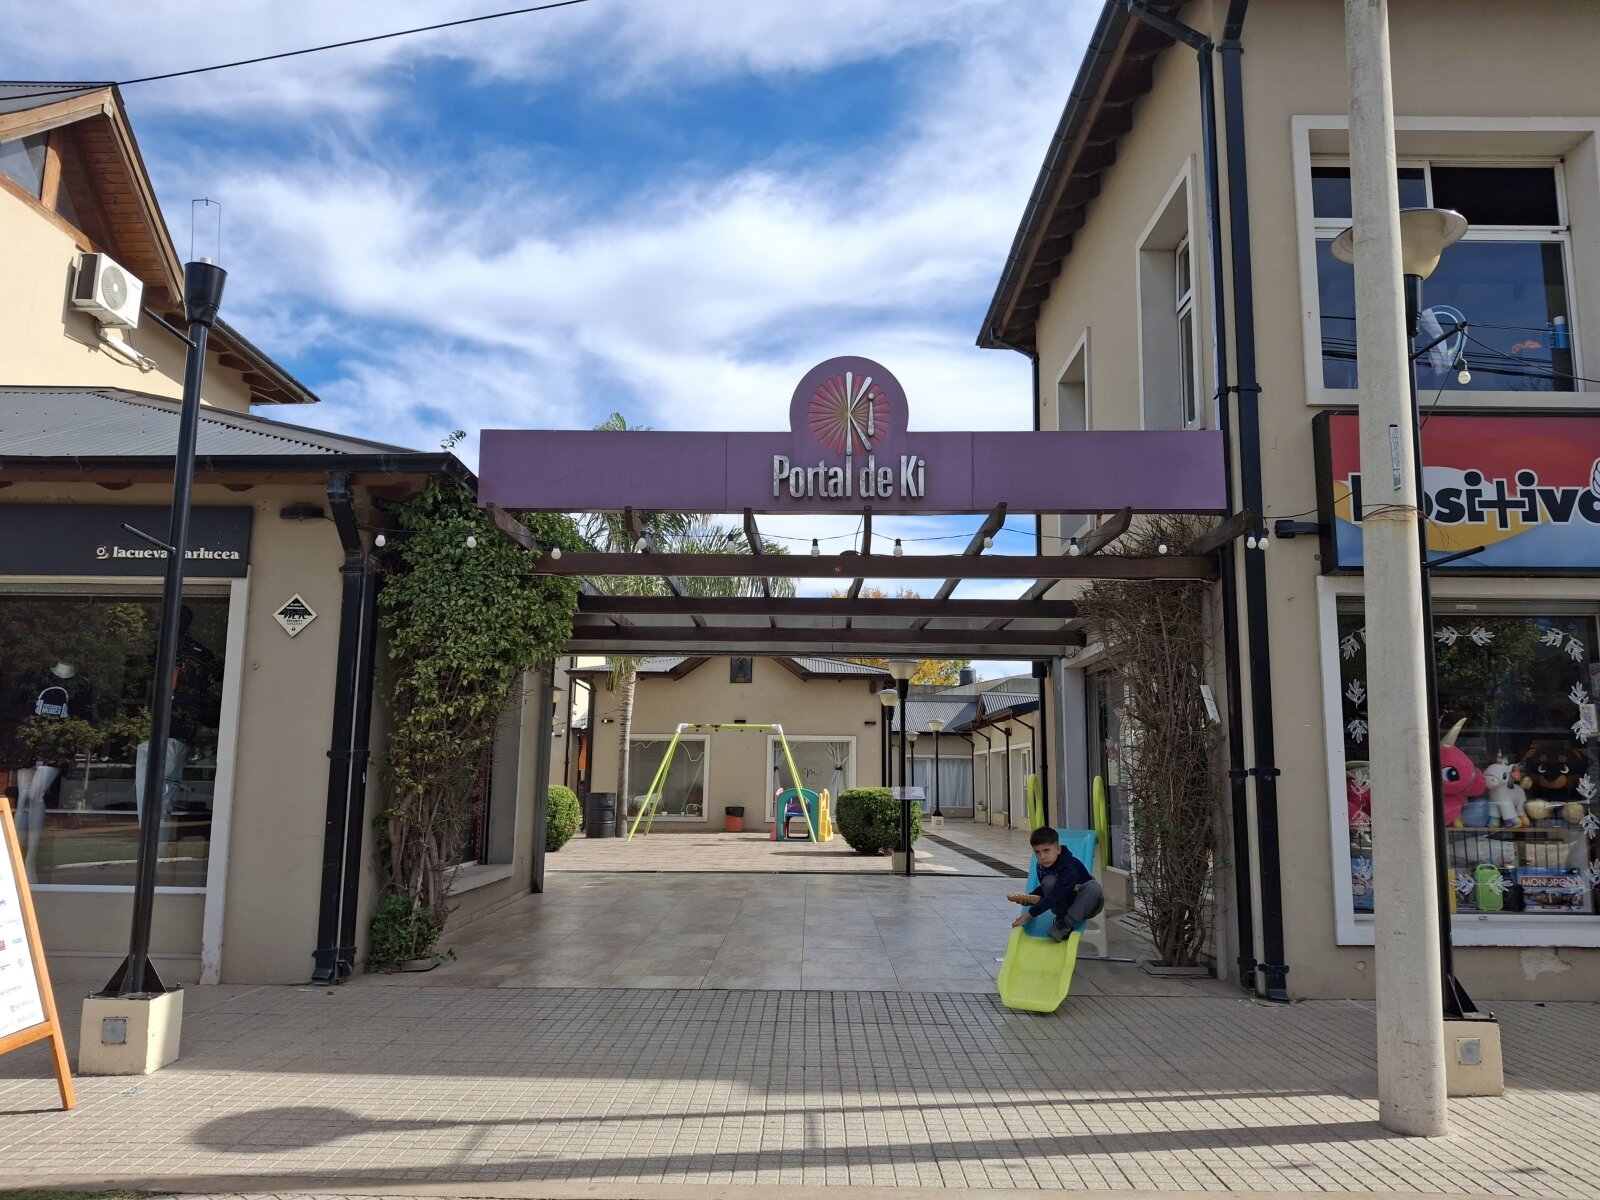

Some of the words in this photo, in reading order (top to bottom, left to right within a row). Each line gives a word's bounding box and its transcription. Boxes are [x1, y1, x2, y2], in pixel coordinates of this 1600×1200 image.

[846, 371, 876, 455] Ki
[773, 454, 852, 498] Portal
[859, 455, 894, 498] de
[900, 455, 925, 498] Ki
[1522, 878, 1579, 888] MONOPO
